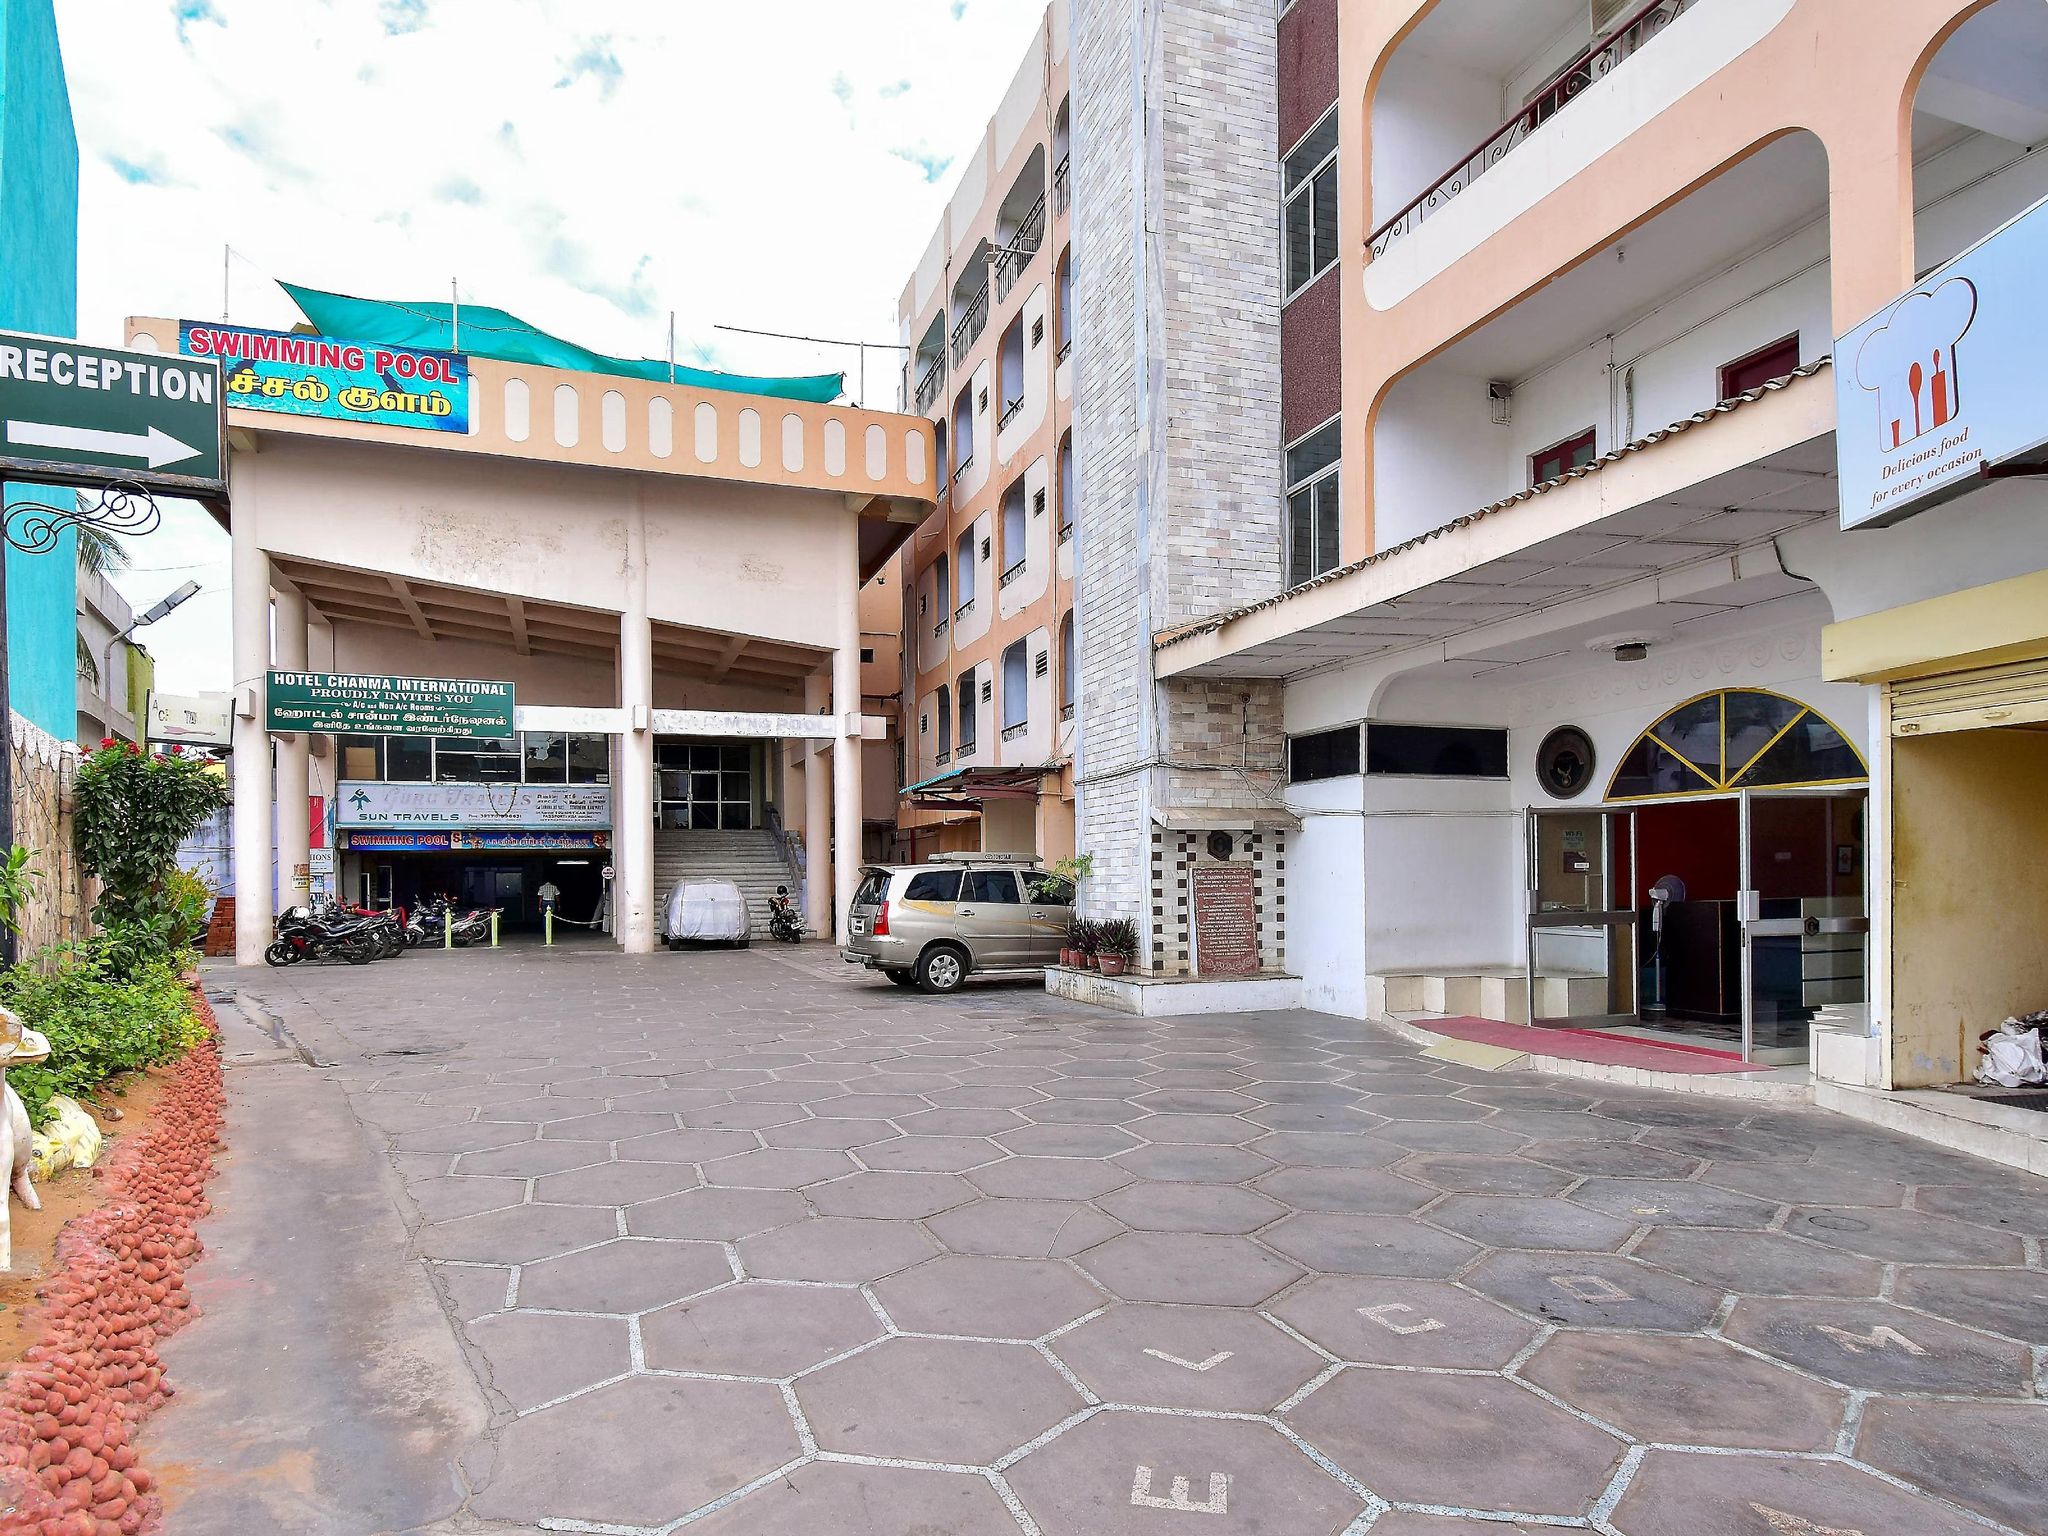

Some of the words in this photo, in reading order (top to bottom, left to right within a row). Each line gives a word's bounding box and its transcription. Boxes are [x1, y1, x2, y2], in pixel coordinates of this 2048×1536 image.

[188, 328, 364, 371] SWIMMING
[374, 350, 459, 384] POOL
[0, 345, 213, 404] RECEPTION
[226, 368, 330, 402] ச்சல்
[337, 384, 453, 417] குளம்
[1881, 447, 1937, 480] Delicious
[1938, 427, 1969, 458] food
[1870, 491, 1889, 510] for
[1891, 474, 1924, 496] every
[1927, 449, 1983, 480] occasion
[274, 673, 322, 687] HOTEL
[328, 676, 391, 690] CHANMA
[396, 679, 507, 696] INTERNATIONAL
[310, 688, 381, 700] PROUDLY
[384, 691, 441, 703] INVITES
[444, 694, 474, 704] YOU
[274, 708, 344, 719] ஹோட்டல்
[379, 702, 394, 710] Non
[410, 704, 434, 712] Rooms
[358, 813, 388, 821] SUN
[393, 813, 460, 821] TRAVELS
[351, 835, 414, 846] SWIMMING
[417, 835, 449, 846] POOL
